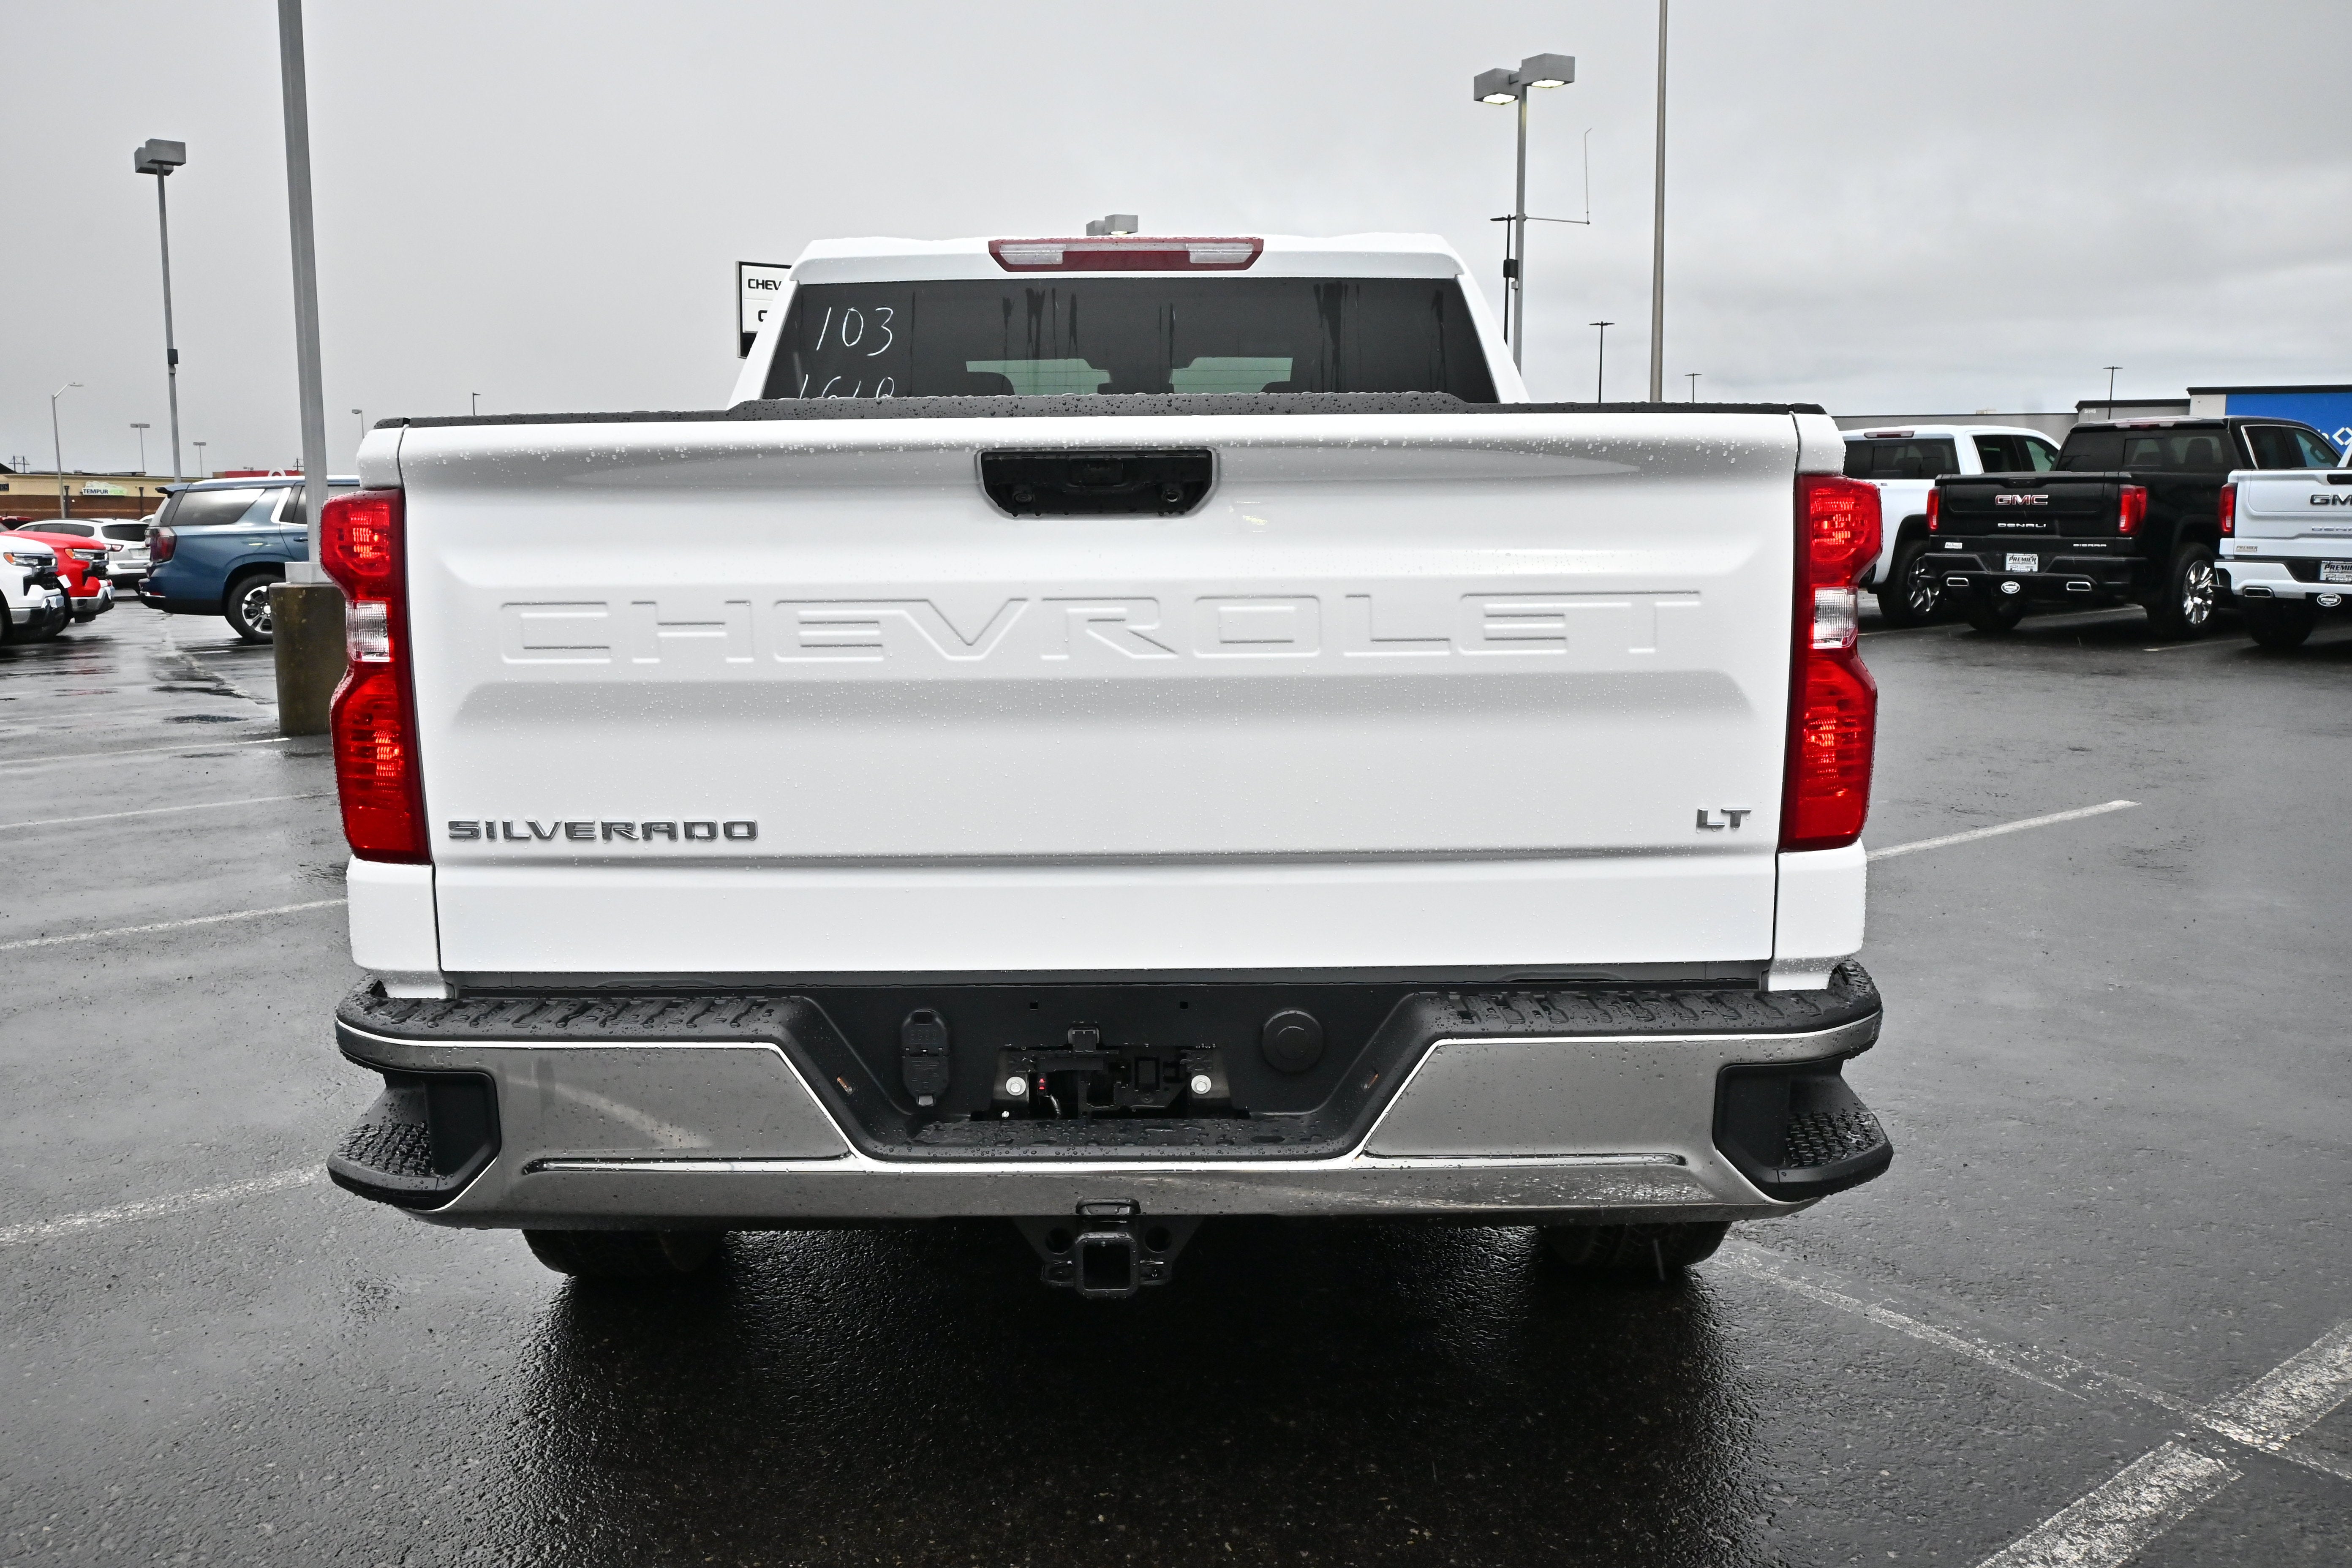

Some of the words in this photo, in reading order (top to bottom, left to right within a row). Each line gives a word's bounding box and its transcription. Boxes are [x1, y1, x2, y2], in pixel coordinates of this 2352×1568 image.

[816, 307, 893, 356] 103
[1995, 495, 2049, 505] GMC
[2009, 555, 2036, 564] PREMIER
[501, 591, 1701, 664] CHEVROLET
[1696, 808, 1752, 828] LT
[447, 819, 759, 841] SILVERADO
